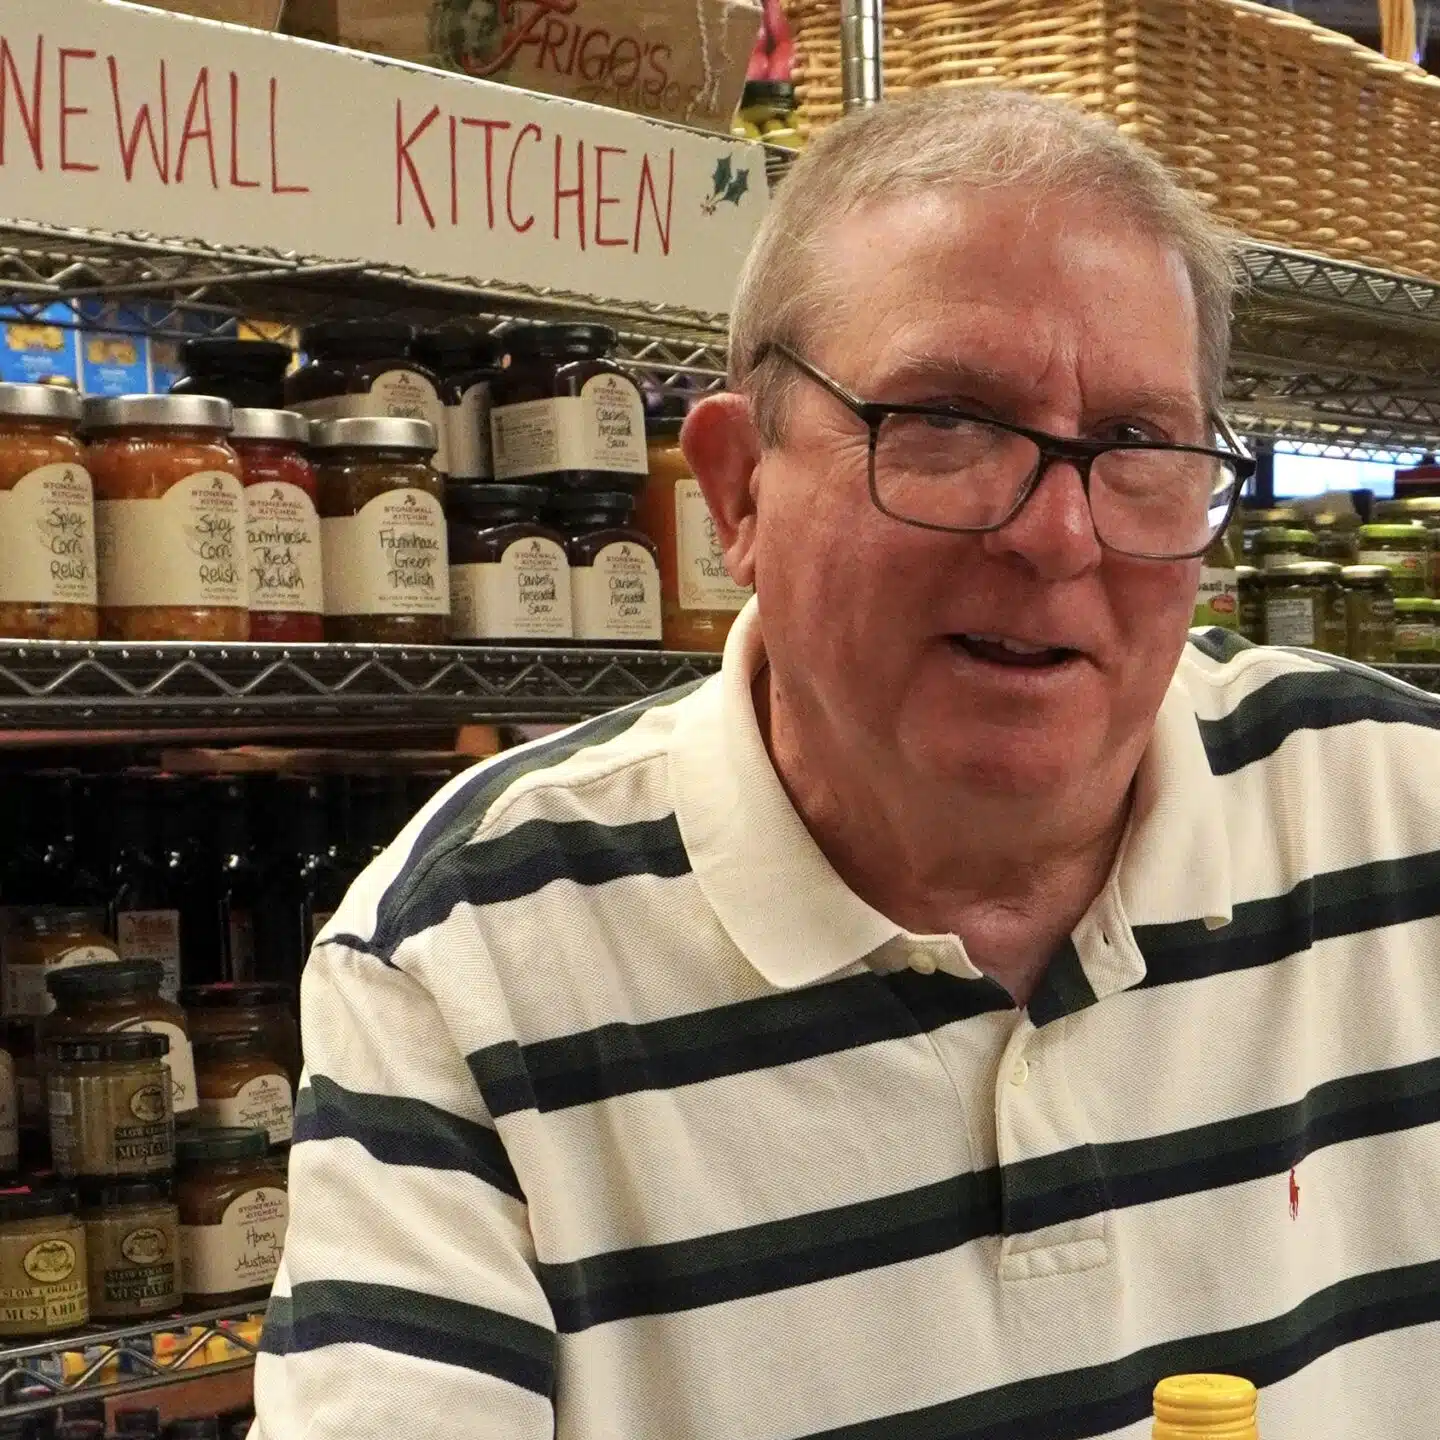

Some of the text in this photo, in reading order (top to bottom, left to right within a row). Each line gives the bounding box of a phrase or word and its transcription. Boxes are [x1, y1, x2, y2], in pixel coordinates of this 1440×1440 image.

[0, 35, 675, 256] NEWALL KITCHEN
[50, 559, 88, 581] Relish
[200, 564, 240, 584] Relish
[246, 1226, 276, 1248] Honey
[5, 1301, 77, 1321] MUSTARD
